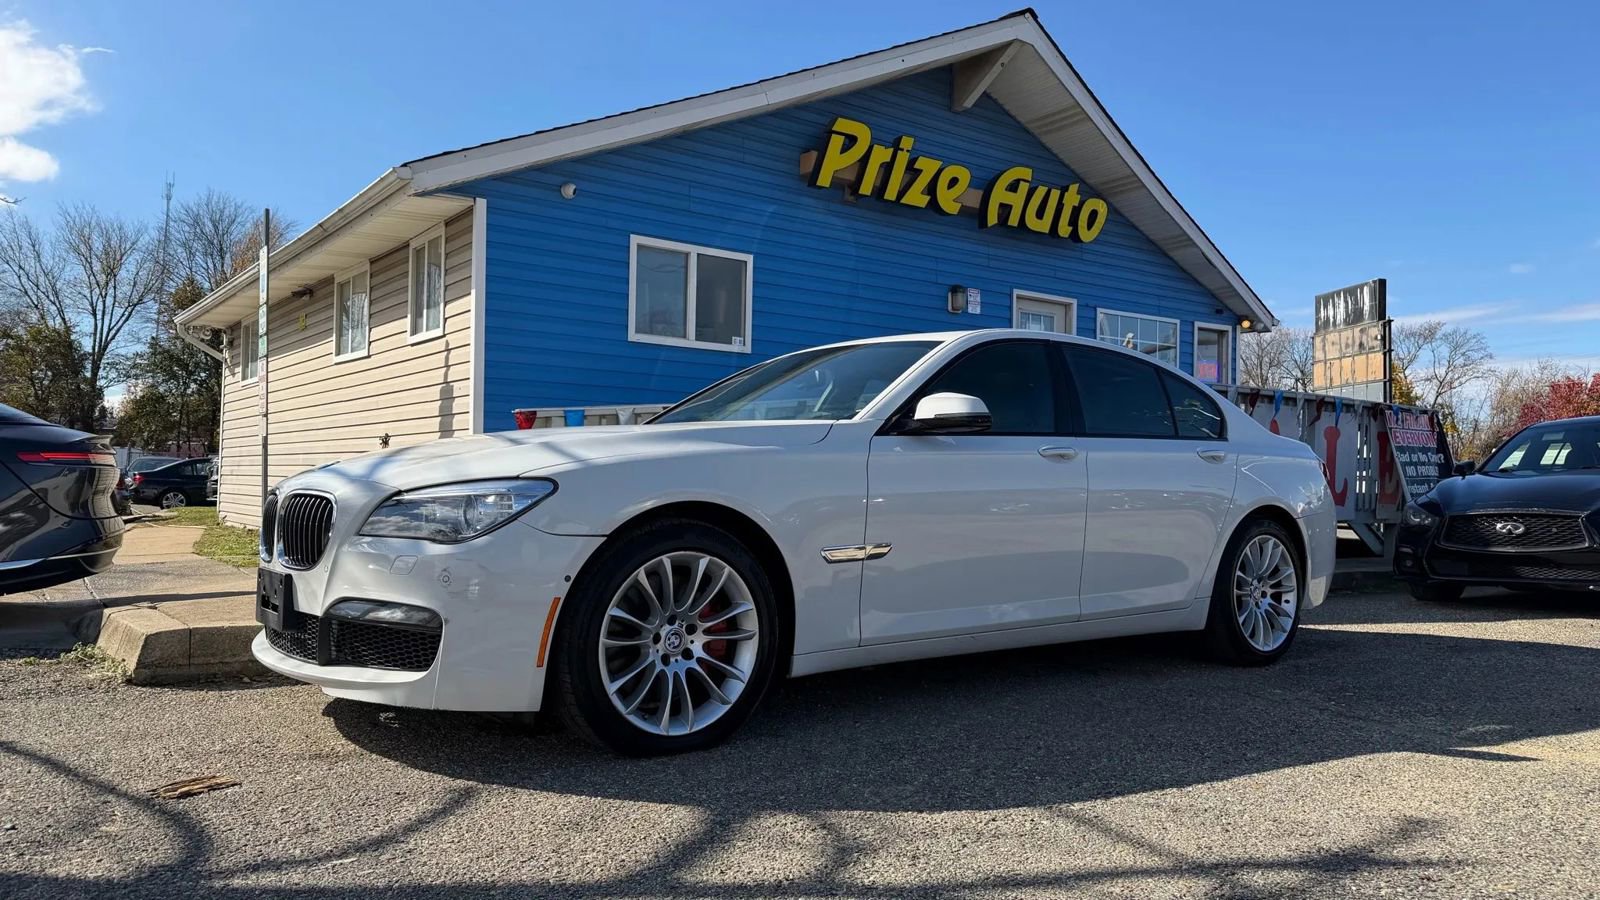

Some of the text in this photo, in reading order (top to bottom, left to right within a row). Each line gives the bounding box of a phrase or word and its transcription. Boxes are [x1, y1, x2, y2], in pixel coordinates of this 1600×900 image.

[814, 117, 1108, 243] Prize Auto
[1405, 465, 1417, 477] NO
